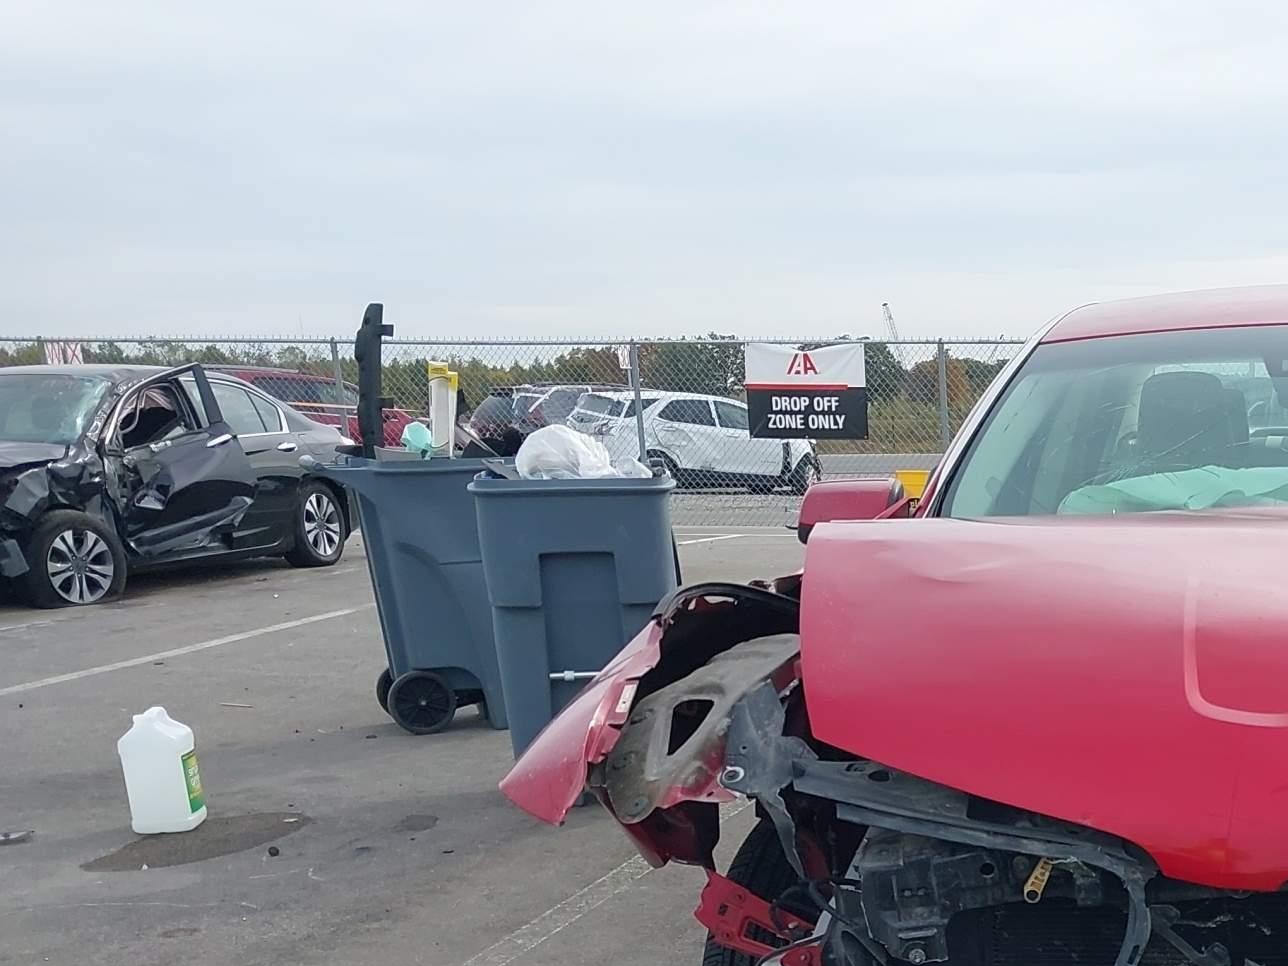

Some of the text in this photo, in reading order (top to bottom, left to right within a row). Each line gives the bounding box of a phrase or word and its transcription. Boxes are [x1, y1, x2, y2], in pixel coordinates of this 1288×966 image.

[771, 396, 840, 412] DROP OFF
[767, 413, 846, 430] ZONE ONLY
